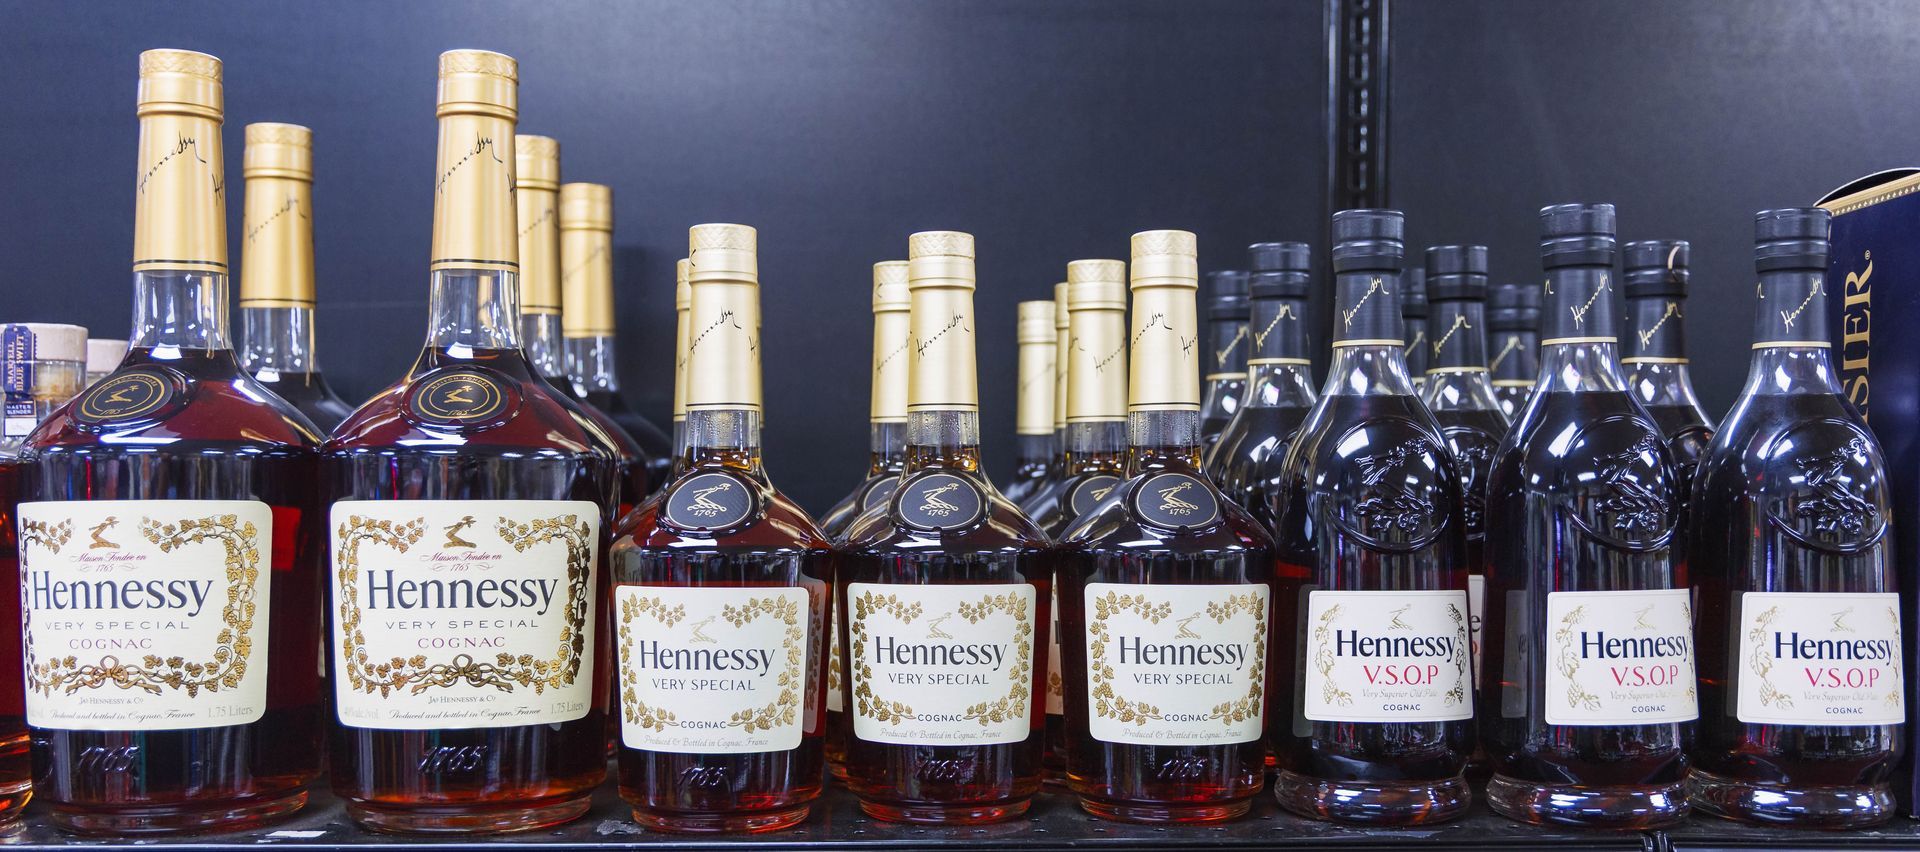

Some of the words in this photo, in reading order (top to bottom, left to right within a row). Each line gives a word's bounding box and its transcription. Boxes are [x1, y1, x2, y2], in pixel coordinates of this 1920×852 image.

[16, 335, 24, 364] SWIFT
[16, 366, 24, 392] BLUE
[694, 509, 718, 518] 1765
[928, 509, 950, 517] 1765
[1169, 508, 1191, 516] 1765
[33, 570, 214, 617] Hennessy
[367, 570, 559, 616] Hennessy
[45, 621, 85, 631] VERY
[95, 620, 190, 630] SPECIAL
[385, 620, 436, 630] VERY
[448, 619, 539, 629] SPECIAL
[69, 638, 152, 650] COGNAC
[418, 637, 506, 649] COGNAC
[1336, 630, 1457, 662] Hennessy
[1581, 631, 1689, 662] Hennessy
[1775, 632, 1894, 666] Hennessy
[640, 640, 776, 677] Hennessy
[875, 636, 1008, 671] Hennessy
[1119, 636, 1249, 671] Hennessy
[888, 673, 923, 685] VERY
[928, 673, 989, 685] SPECIAL
[1133, 673, 1171, 685] VERY
[1175, 673, 1233, 685] SPECIAL
[1363, 665, 1439, 685] V.S.O.P
[1610, 665, 1679, 686] V.S.O.P
[1804, 667, 1880, 689] V.S.O.P
[652, 678, 687, 690] VERY
[691, 679, 756, 691] SPECIAL
[208, 707, 227, 718] 1.75
[229, 705, 253, 716] Liters
[567, 701, 584, 712] Liters
[1632, 705, 1666, 713] COGNAC
[425, 711, 442, 719] and
[443, 711, 468, 719] bottled
[917, 714, 962, 722] COGNAC
[1164, 714, 1208, 722] COGNAC
[681, 721, 727, 729] COGNAC
